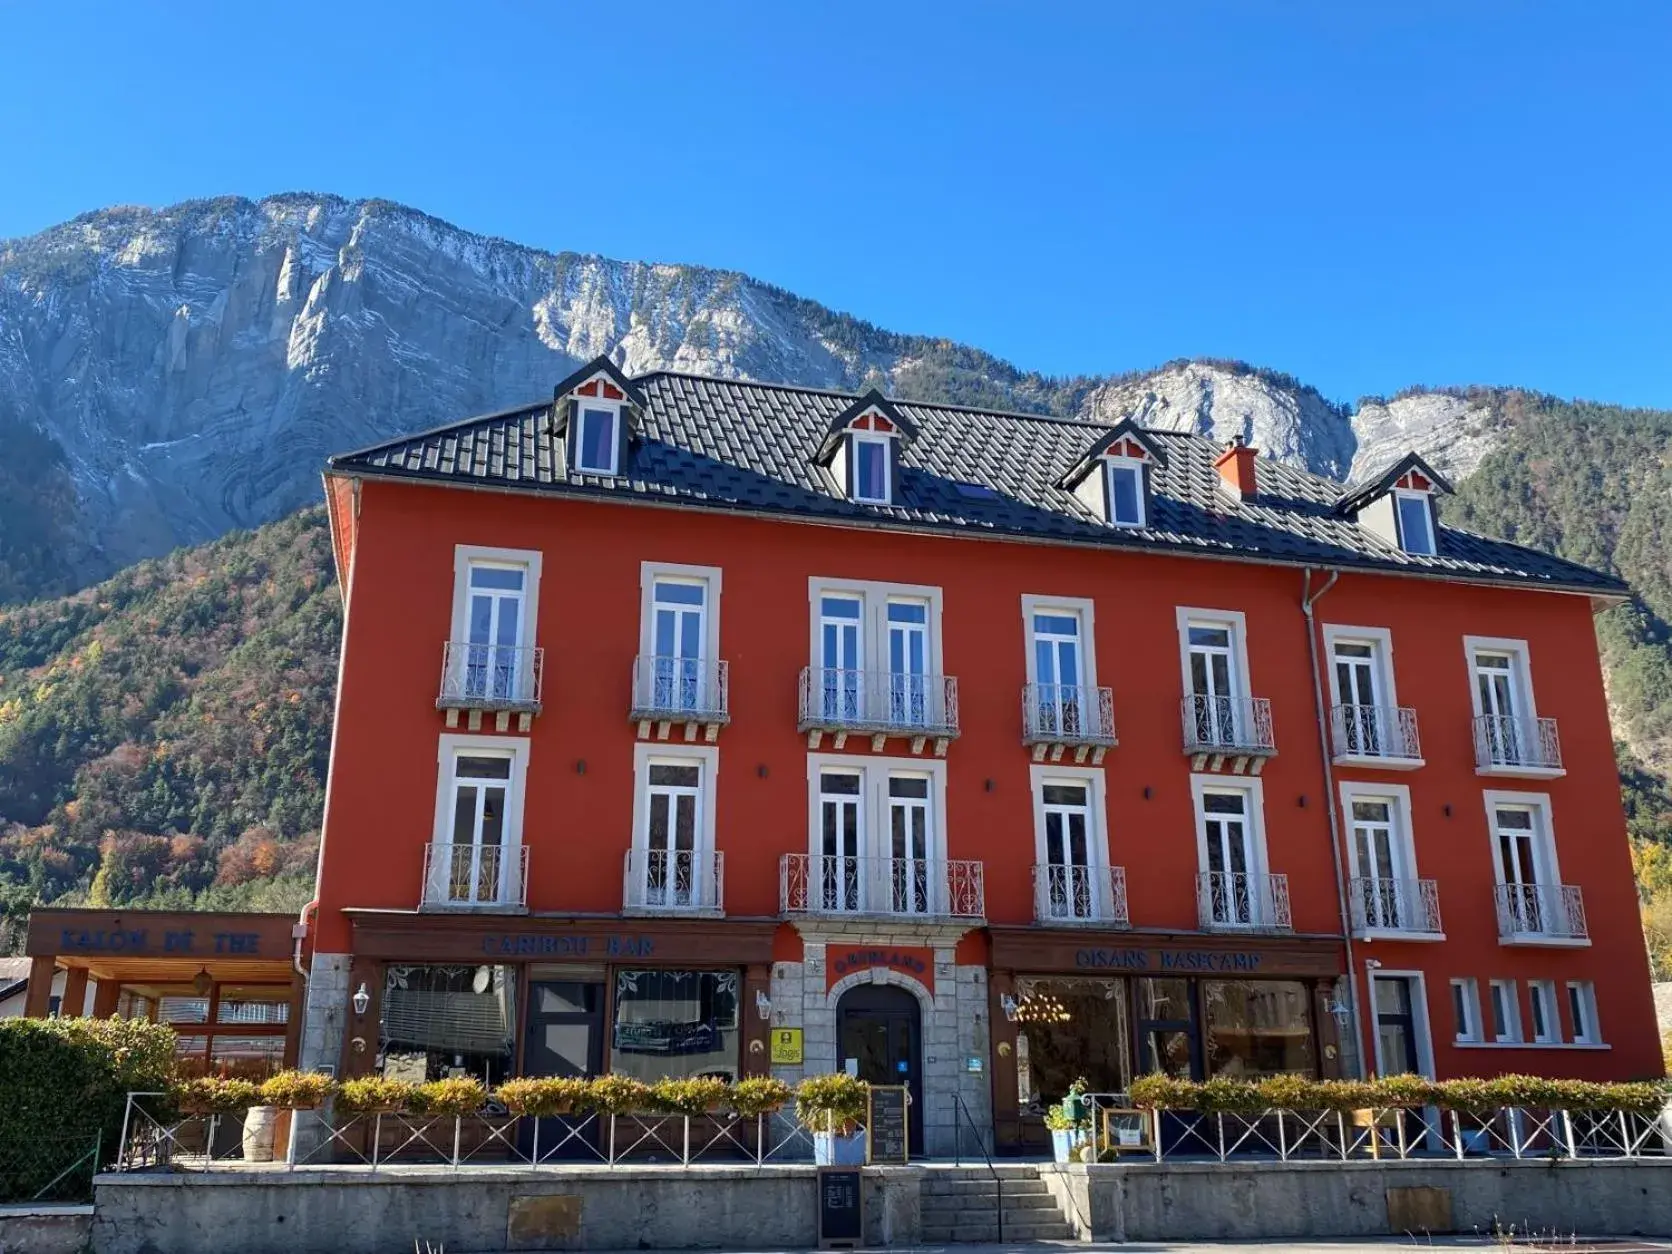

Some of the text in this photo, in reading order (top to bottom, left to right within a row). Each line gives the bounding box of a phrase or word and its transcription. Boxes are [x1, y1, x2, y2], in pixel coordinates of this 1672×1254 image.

[165, 928, 195, 952] DE
[484, 935, 655, 957] CARIBOU BAR
[1076, 949, 1263, 971] OISANS BASECAMP
